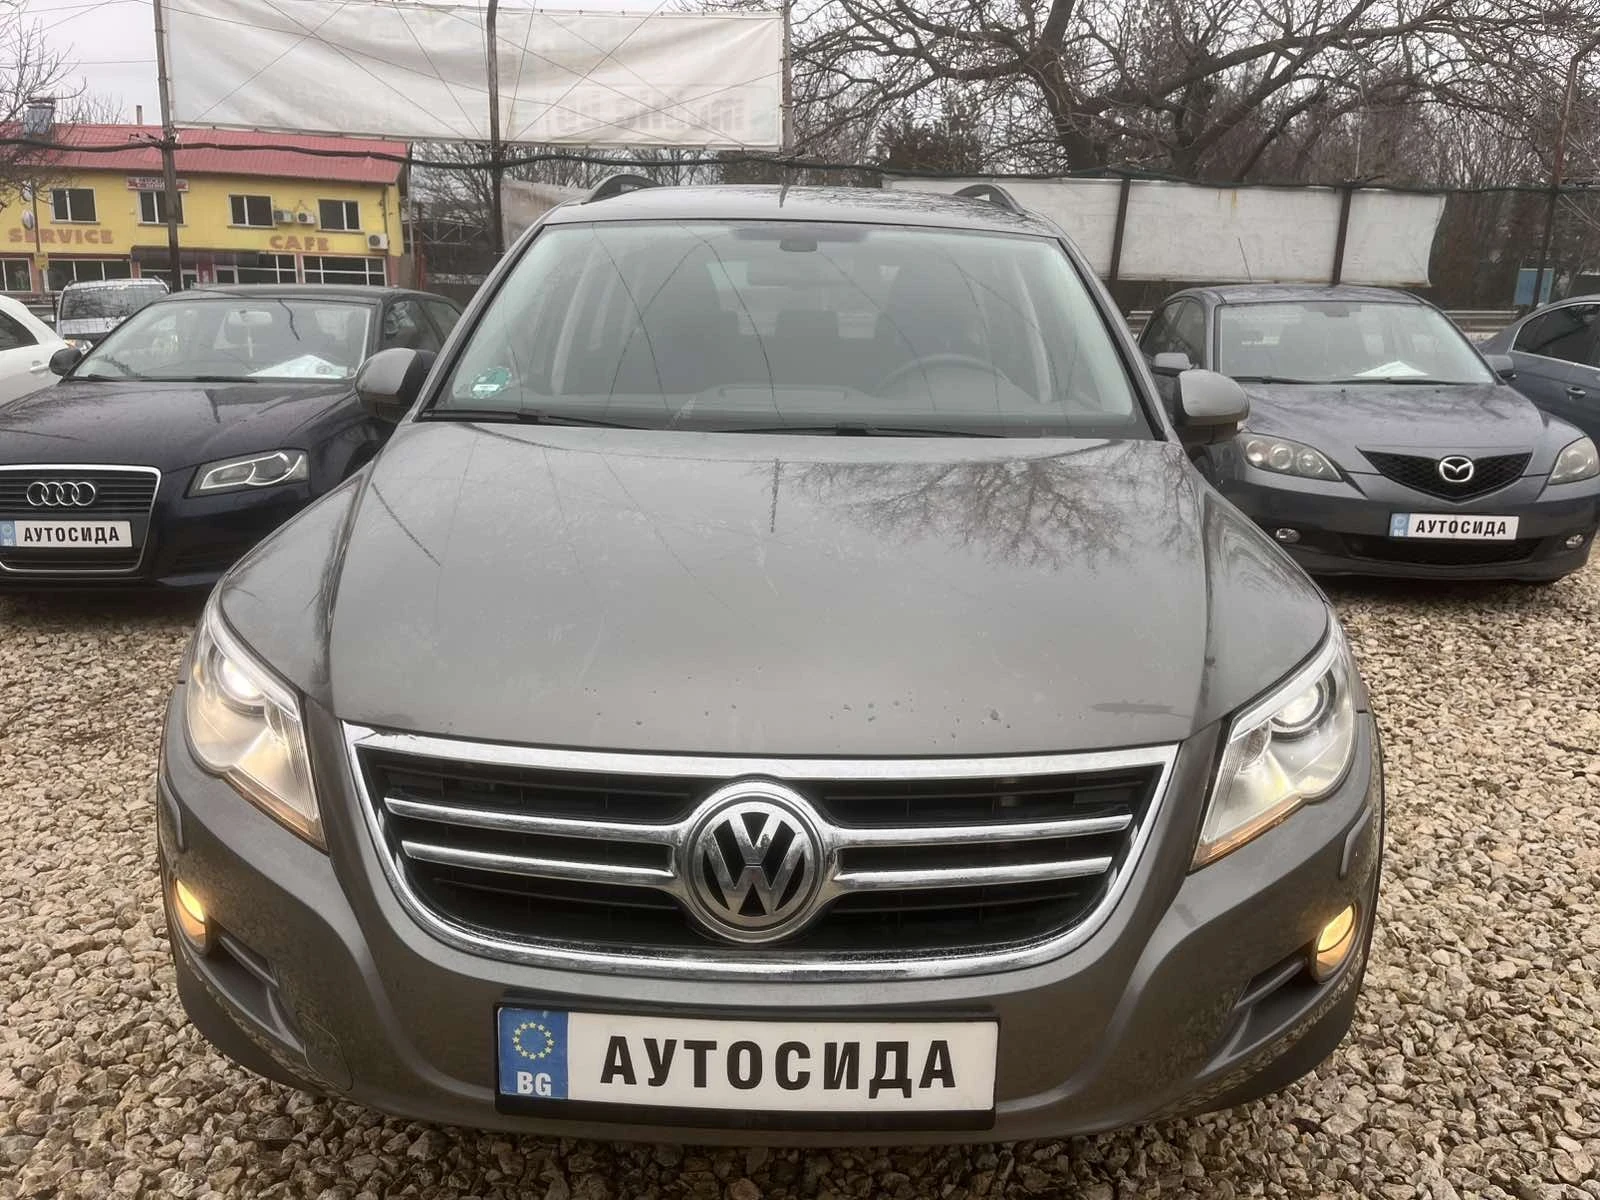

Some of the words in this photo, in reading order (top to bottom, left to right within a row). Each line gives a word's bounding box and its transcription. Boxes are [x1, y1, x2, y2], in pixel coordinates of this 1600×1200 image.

[8, 228, 113, 244] SERVICE
[269, 235, 329, 251] CAFE
[24, 527, 120, 544] АУТОСИДА
[1415, 520, 1507, 537] АУТОСИДА
[599, 1034, 957, 1099] АУТОСИДА
[517, 1071, 552, 1097] BG
